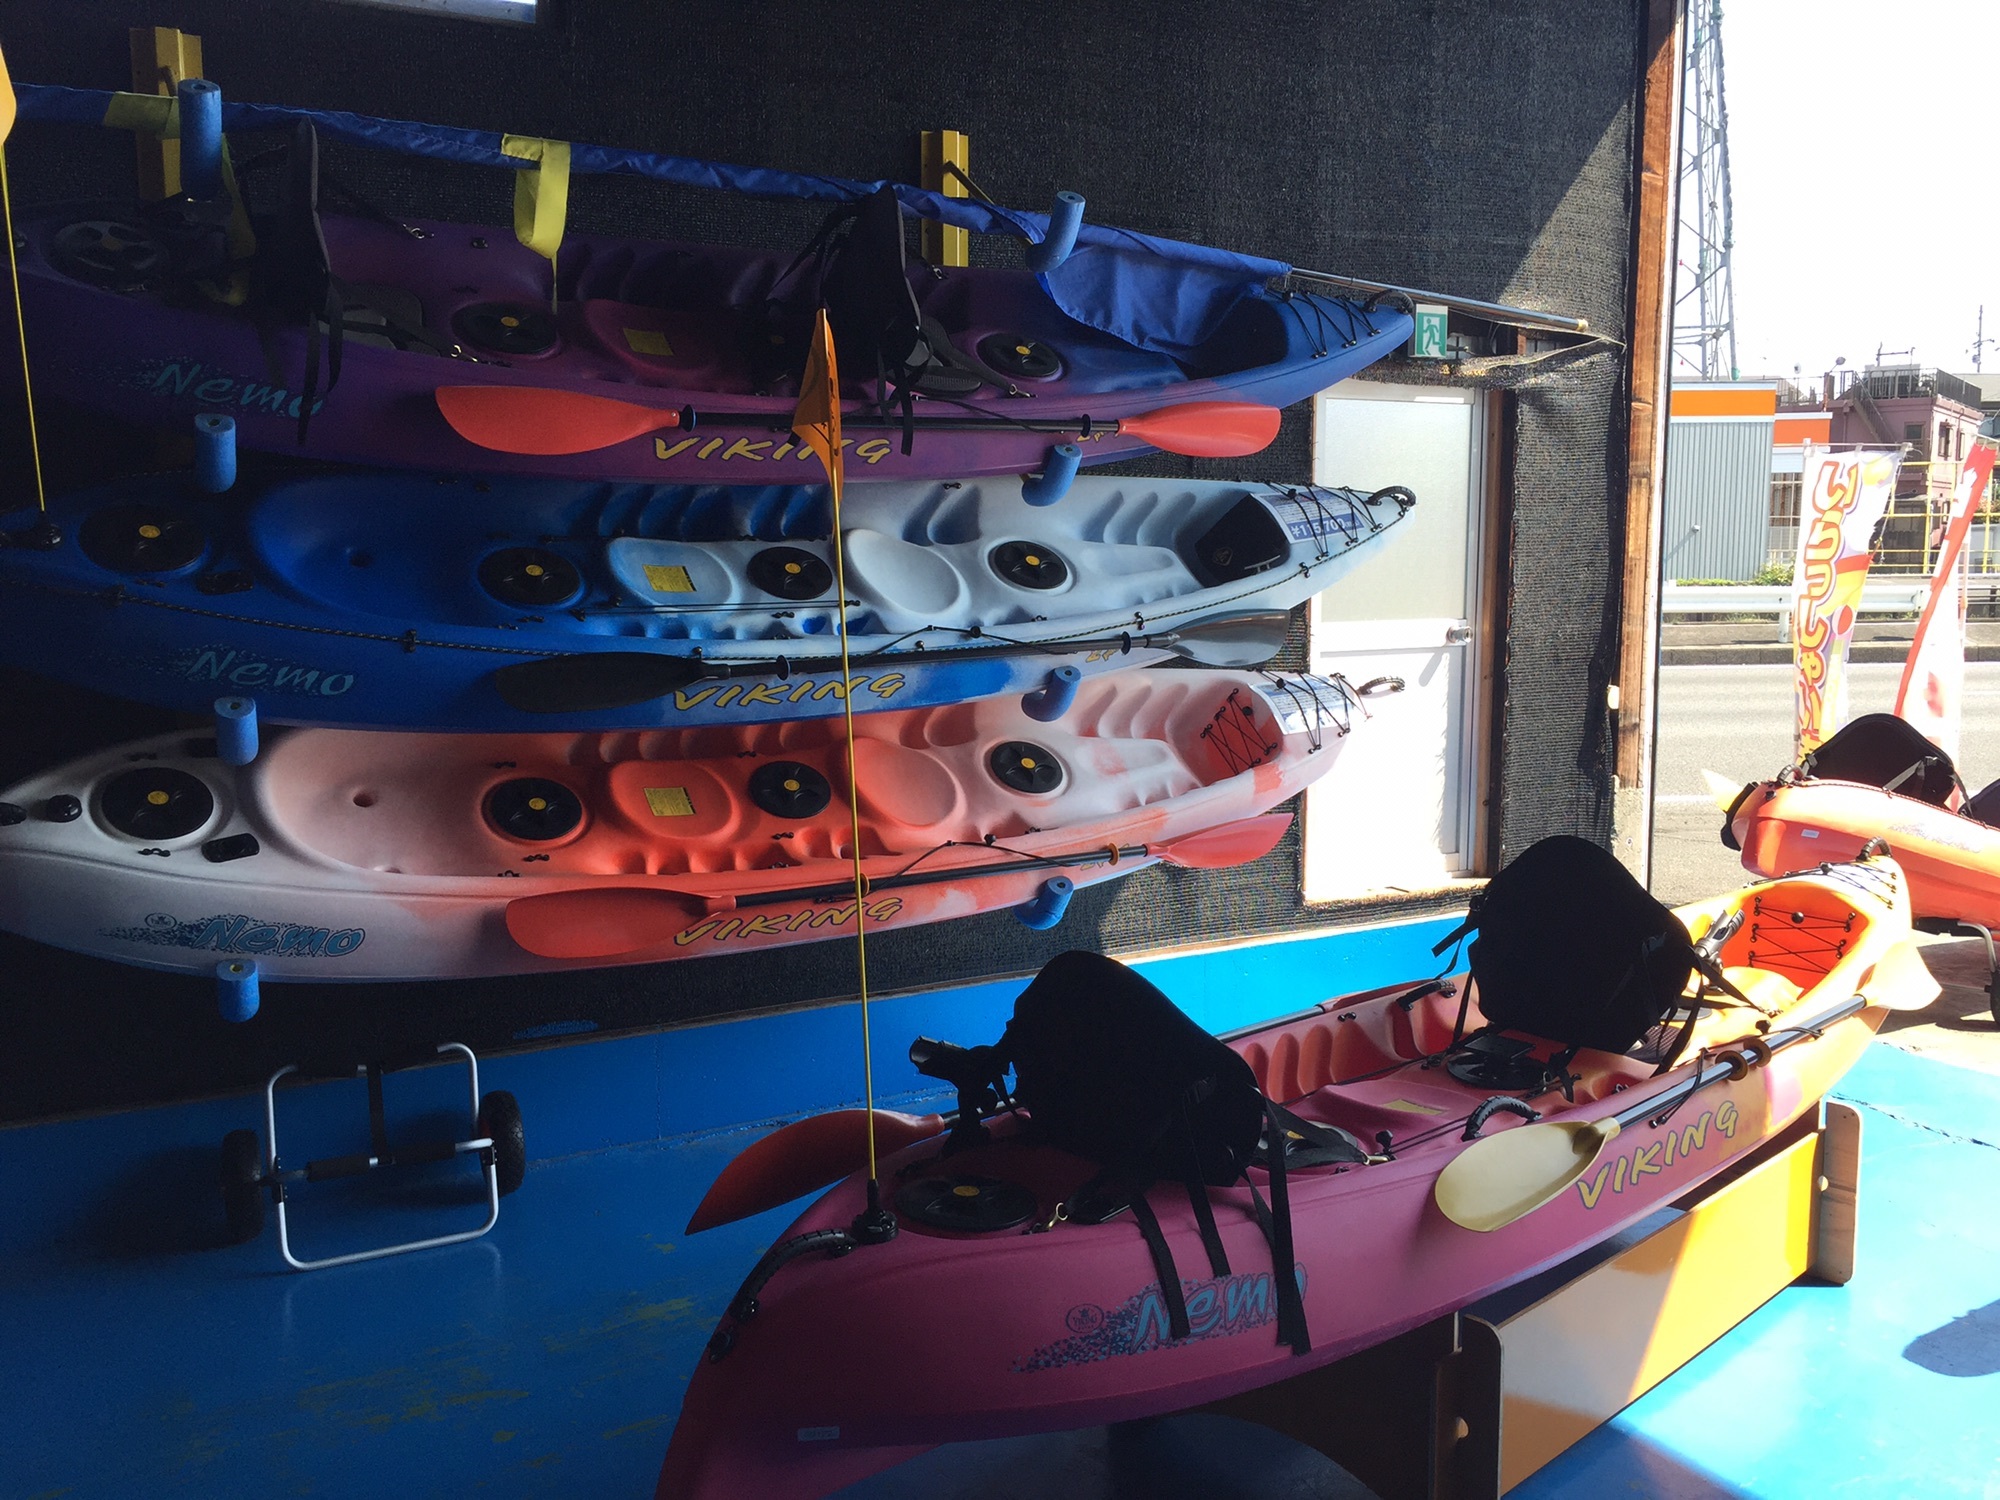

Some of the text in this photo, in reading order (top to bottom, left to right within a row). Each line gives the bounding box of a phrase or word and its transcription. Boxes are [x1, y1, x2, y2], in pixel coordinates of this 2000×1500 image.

[152, 363, 324, 418] Nemo
[1290, 517, 1346, 537] ¥115700
[185, 650, 355, 695] Nemo
[674, 673, 904, 711] VIKING
[192, 914, 365, 956] Nemo
[674, 897, 902, 946] VIKING
[1577, 1101, 1739, 1209] VIKING
